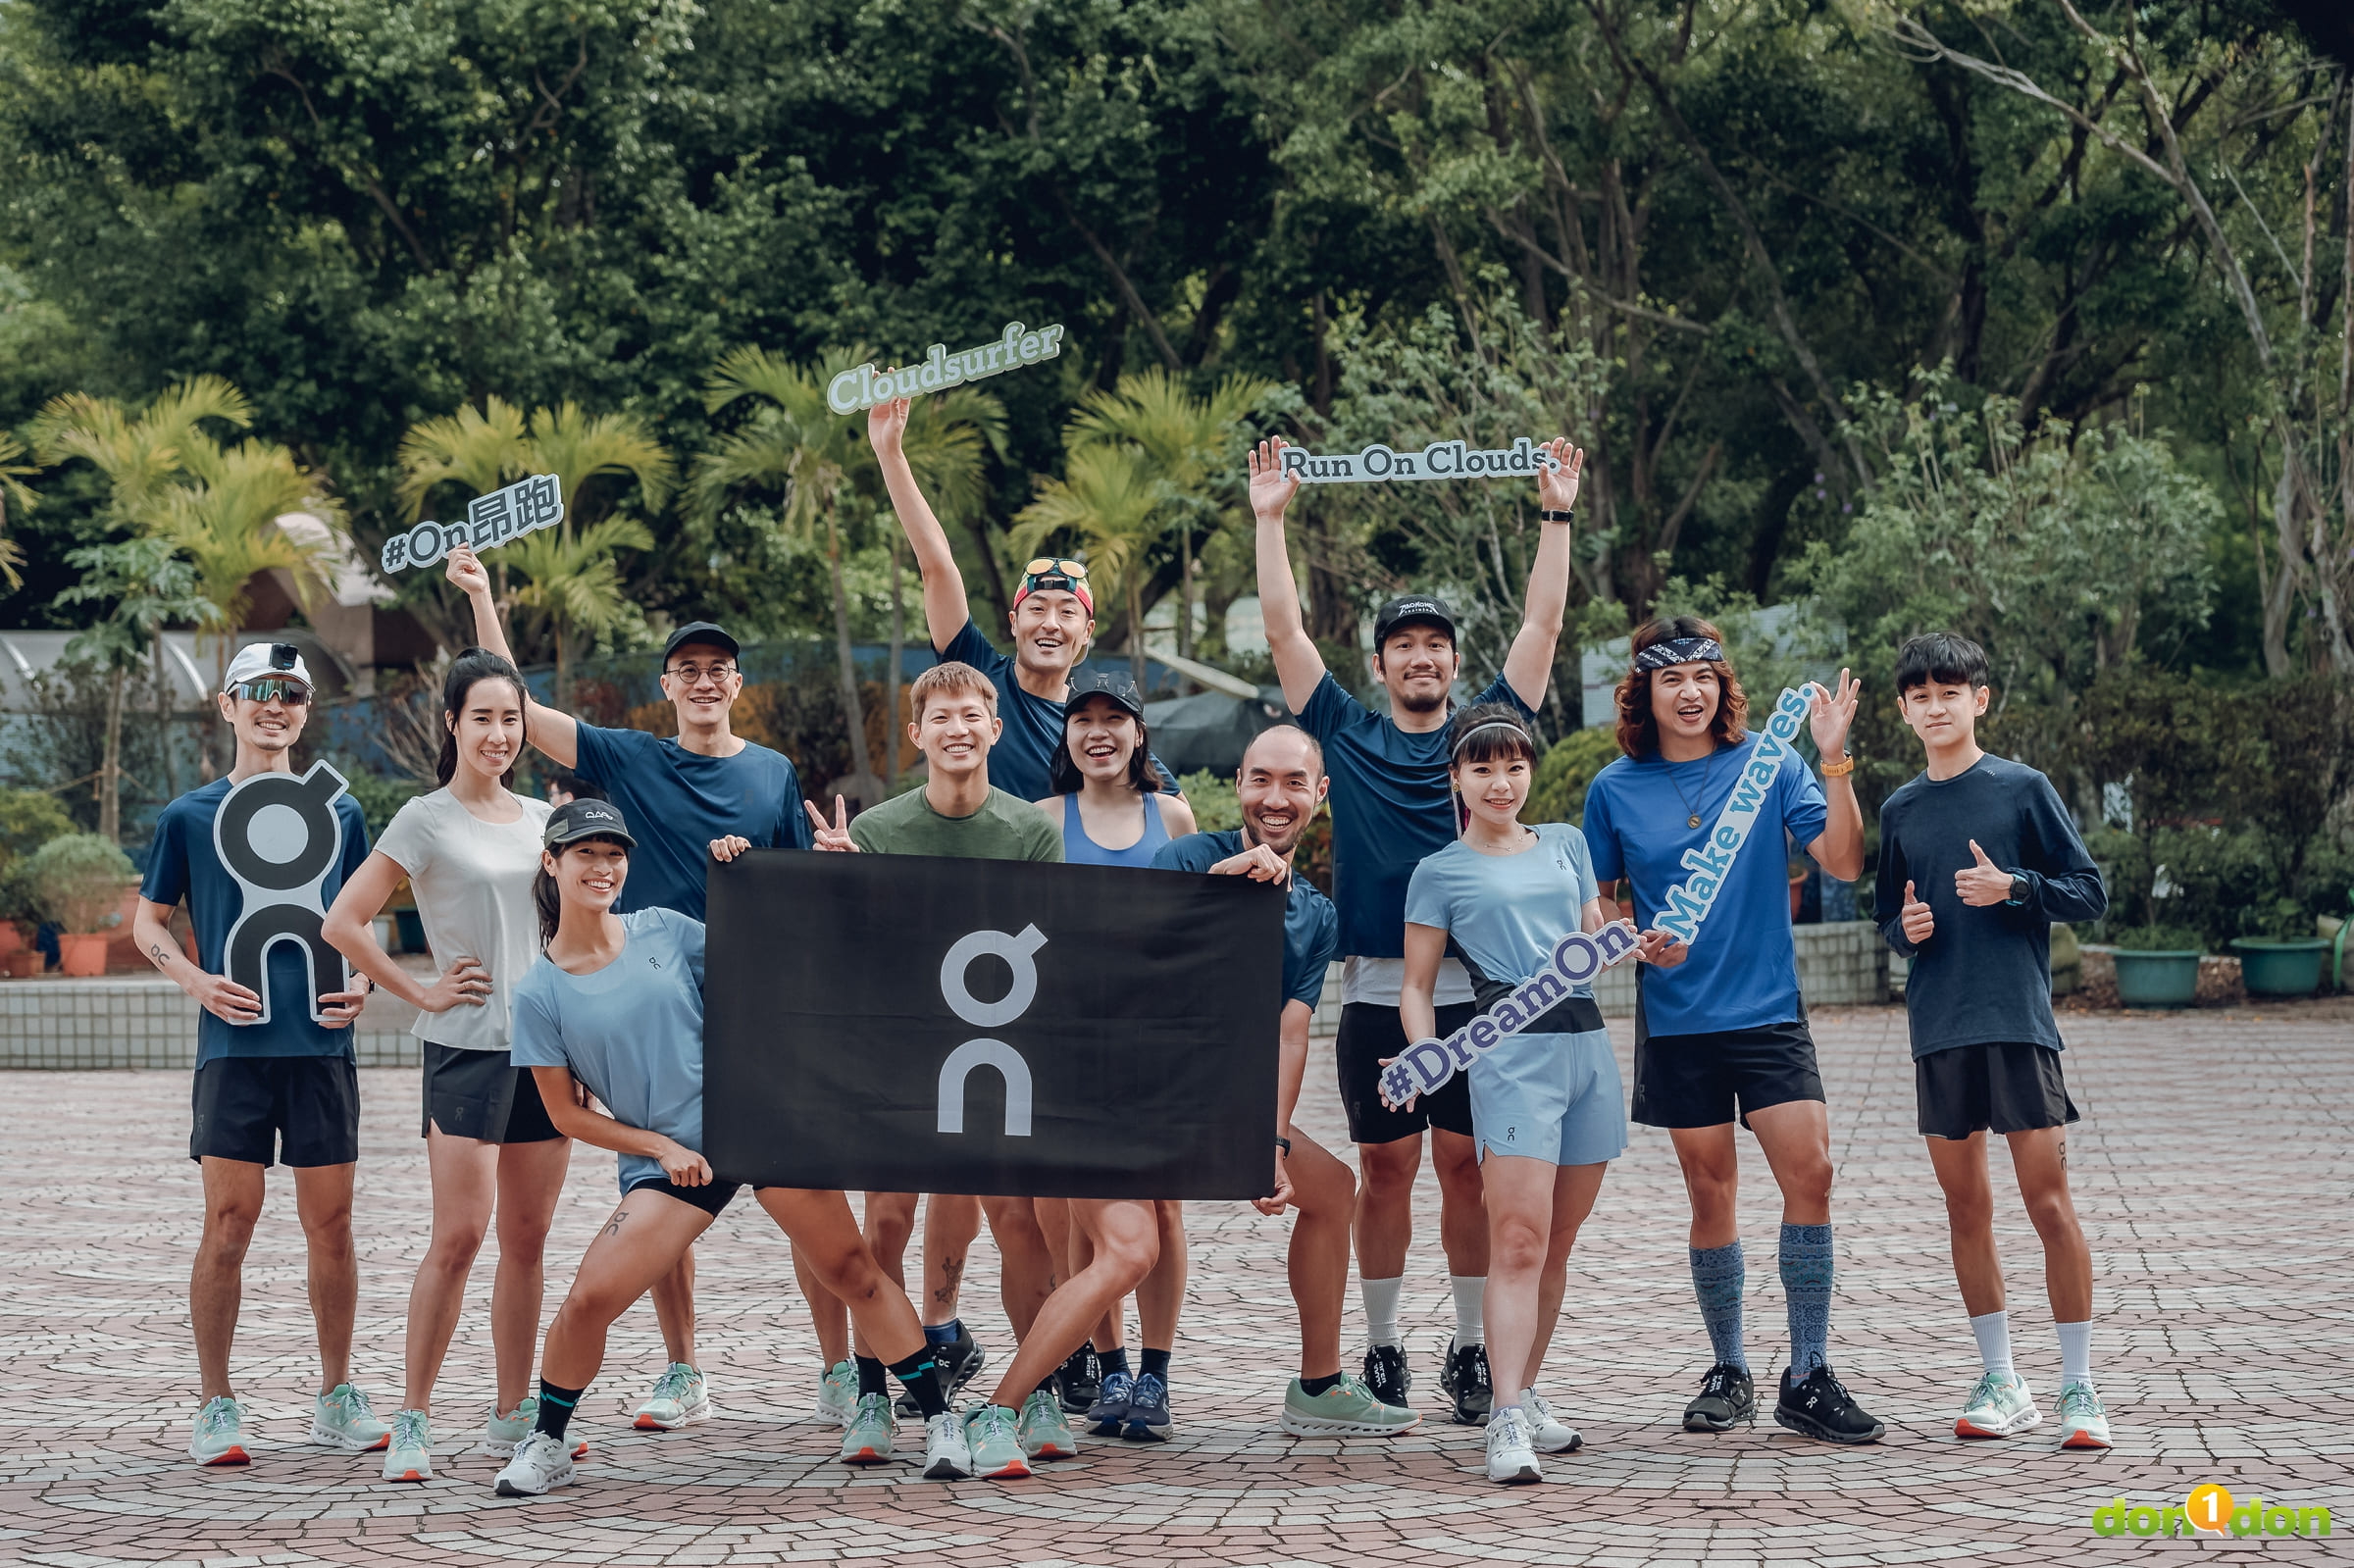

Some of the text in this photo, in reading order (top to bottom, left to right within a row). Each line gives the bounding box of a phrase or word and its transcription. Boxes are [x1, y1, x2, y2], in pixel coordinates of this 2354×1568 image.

[829, 324, 1059, 411] Cloudsurfer
[1284, 451, 1353, 478] Run
[1363, 448, 1416, 476] On
[1657, 684, 1815, 940] Make waves.
[1385, 925, 1636, 1102] #DreamOn
